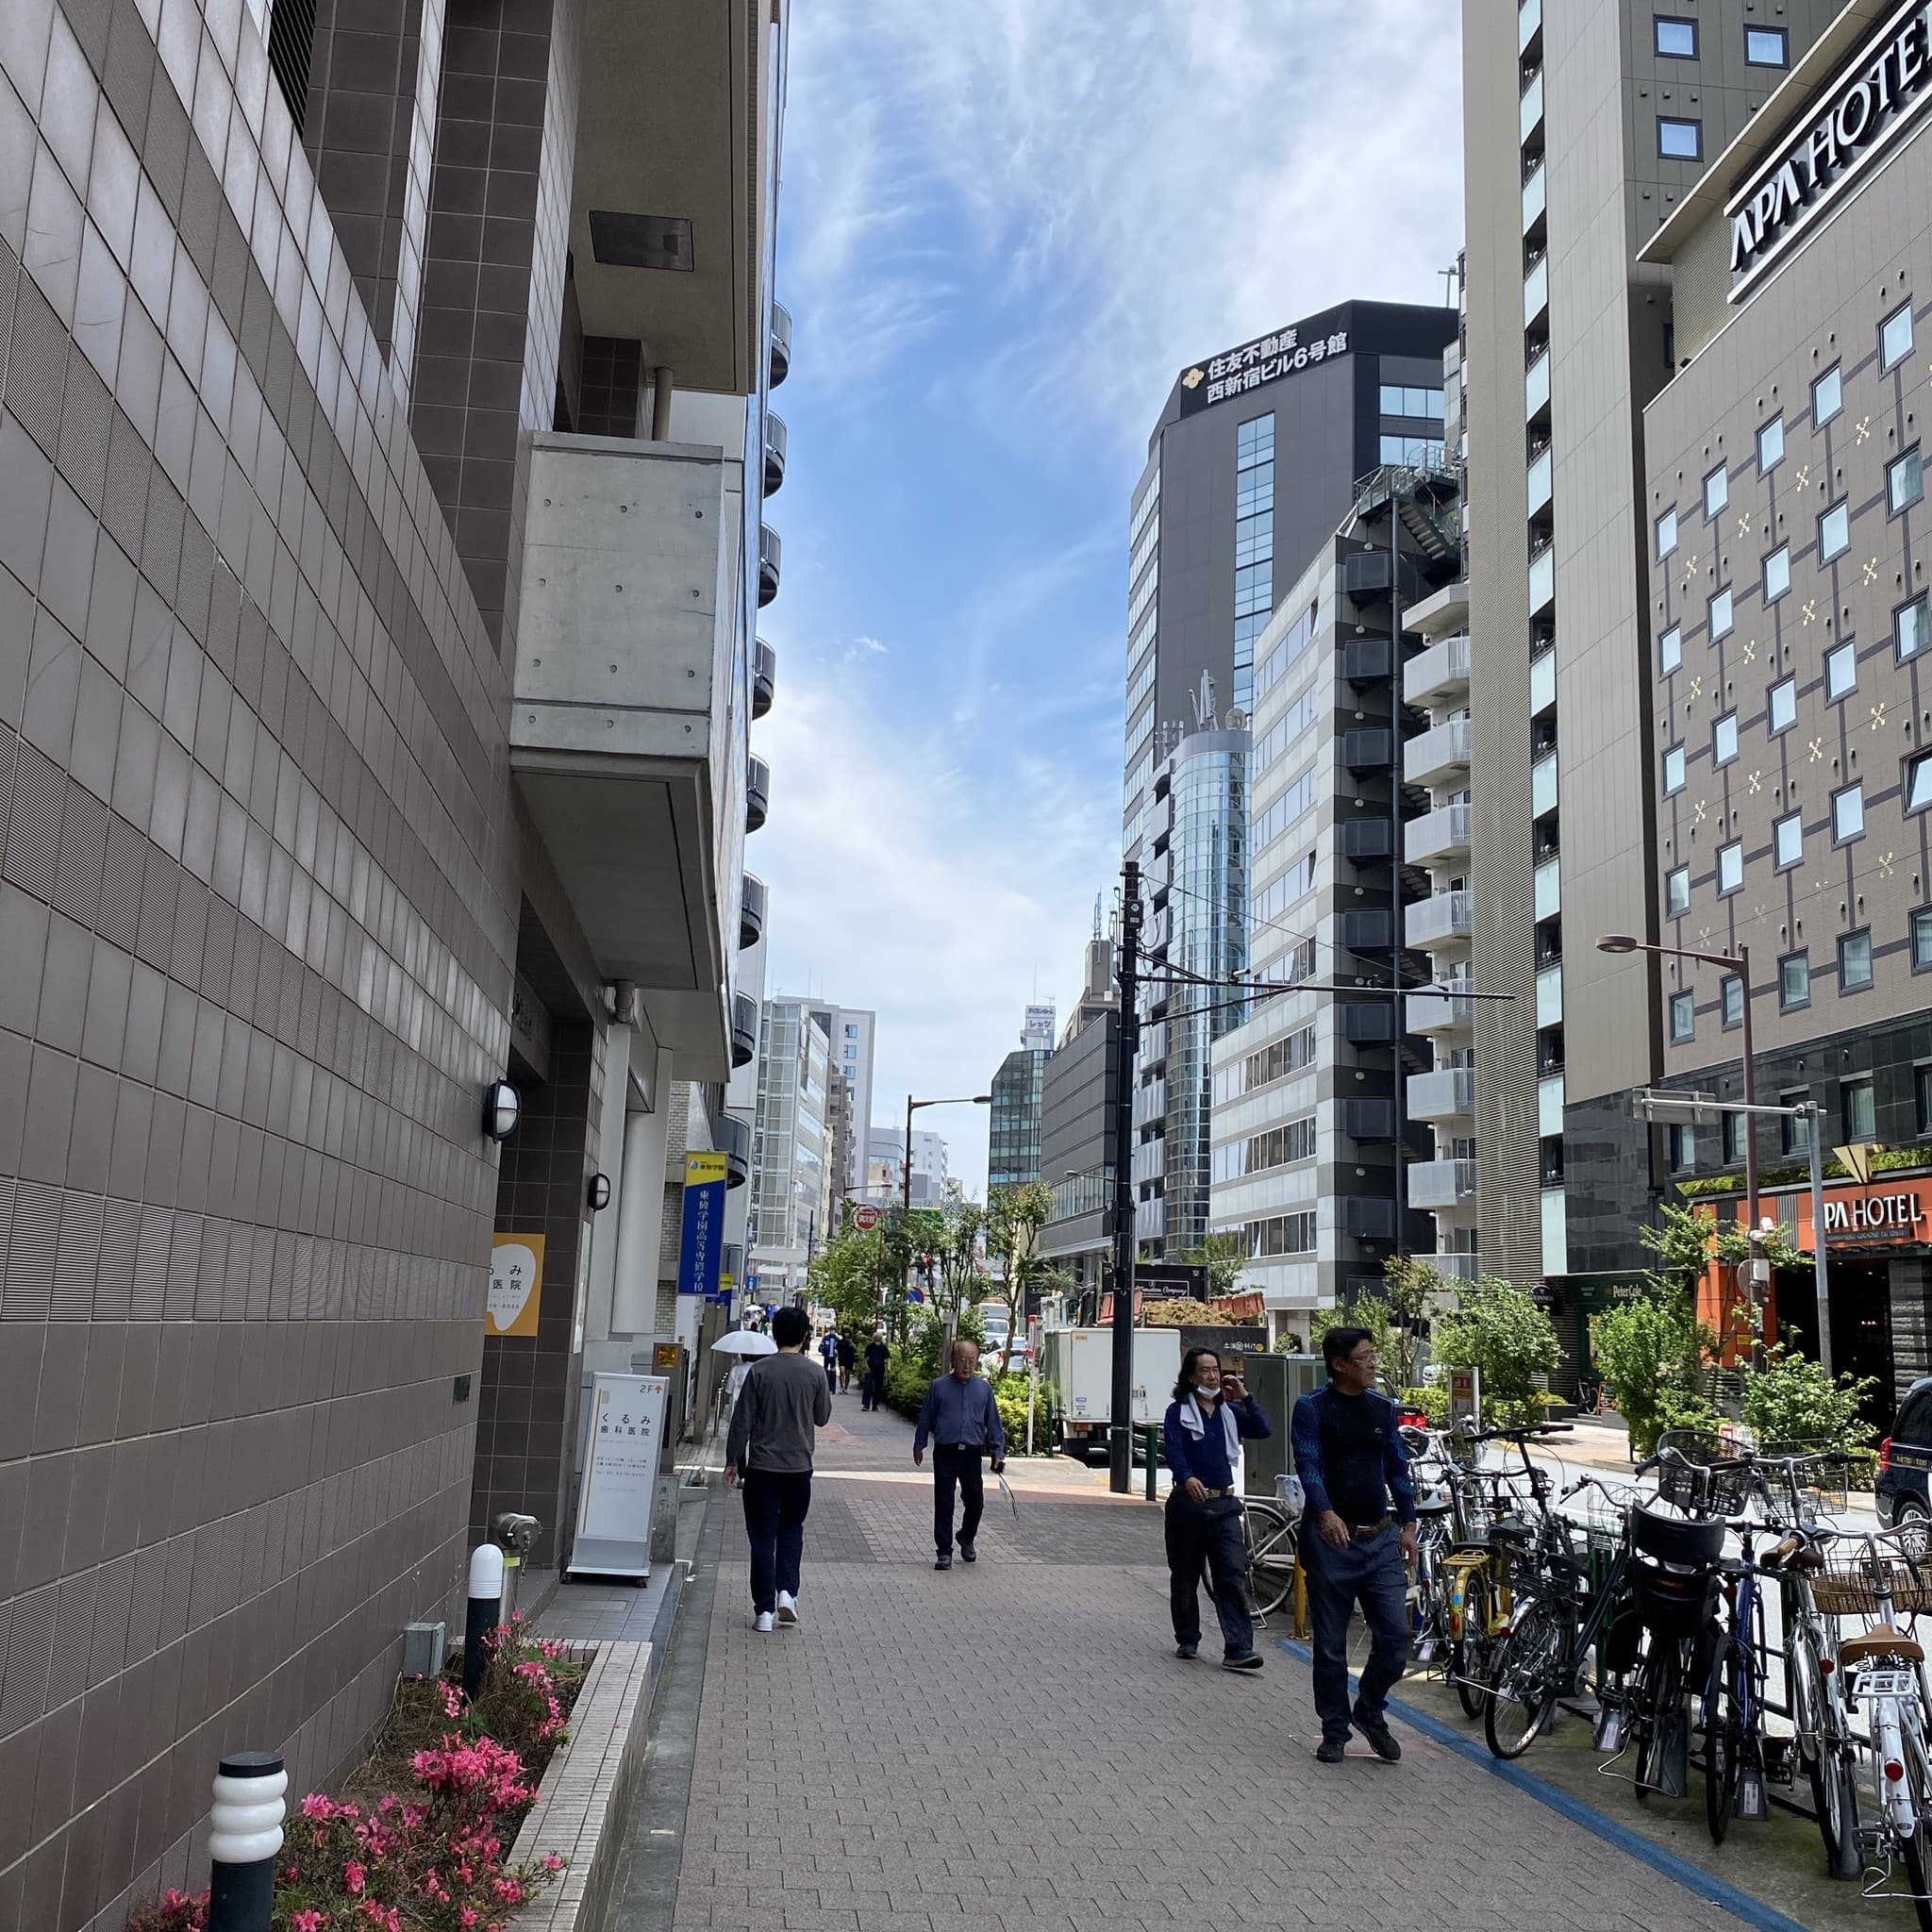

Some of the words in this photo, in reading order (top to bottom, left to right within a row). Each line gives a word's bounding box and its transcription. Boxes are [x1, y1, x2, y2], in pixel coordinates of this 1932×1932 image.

[1730, 158, 1801, 272] APA
[1207, 331, 1348, 405] 西新宿ビル6号館
[1208, 328, 1298, 380] 住友不動産
[1853, 1192, 1923, 1226] HOTEL
[640, 1384, 654, 1393] 2F
[600, 1425, 650, 1437] 歯科医院
[602, 1412, 651, 1424] くるみ
